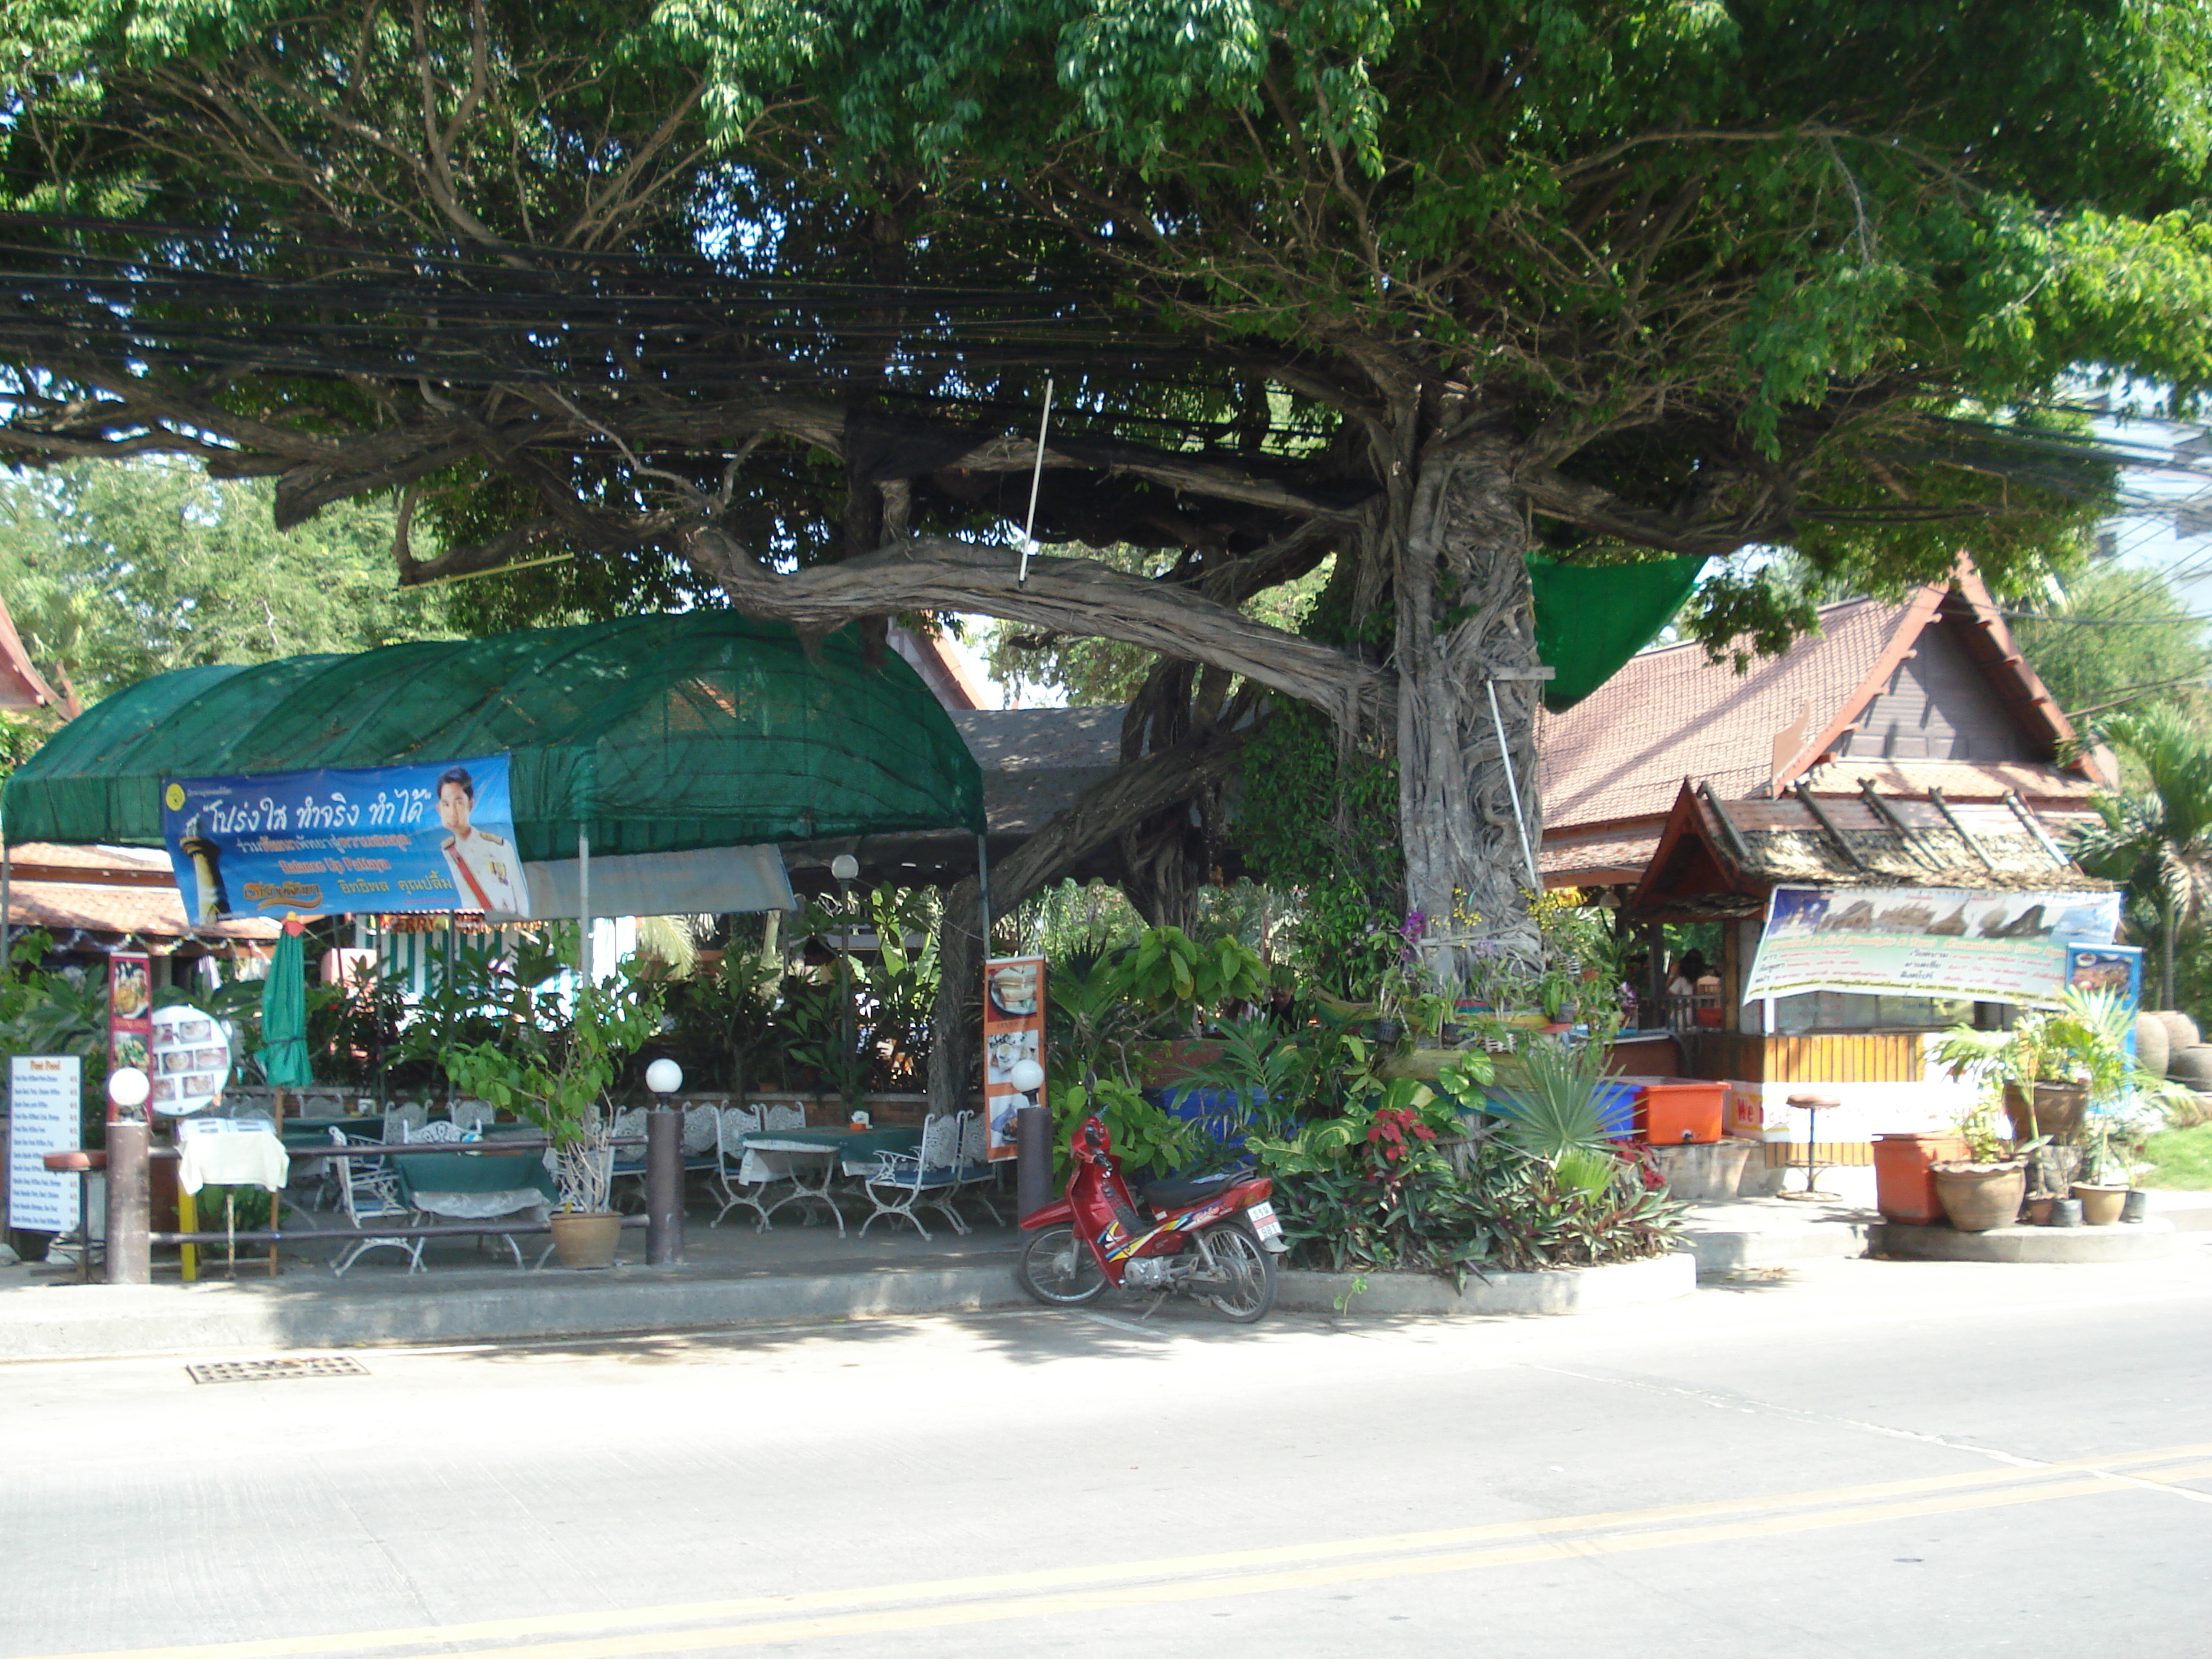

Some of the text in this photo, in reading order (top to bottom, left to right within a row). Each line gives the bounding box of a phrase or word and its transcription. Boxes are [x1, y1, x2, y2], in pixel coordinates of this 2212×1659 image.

[338, 877, 390, 895] อิทธิพล
[1736, 1097, 1754, 1123] We
